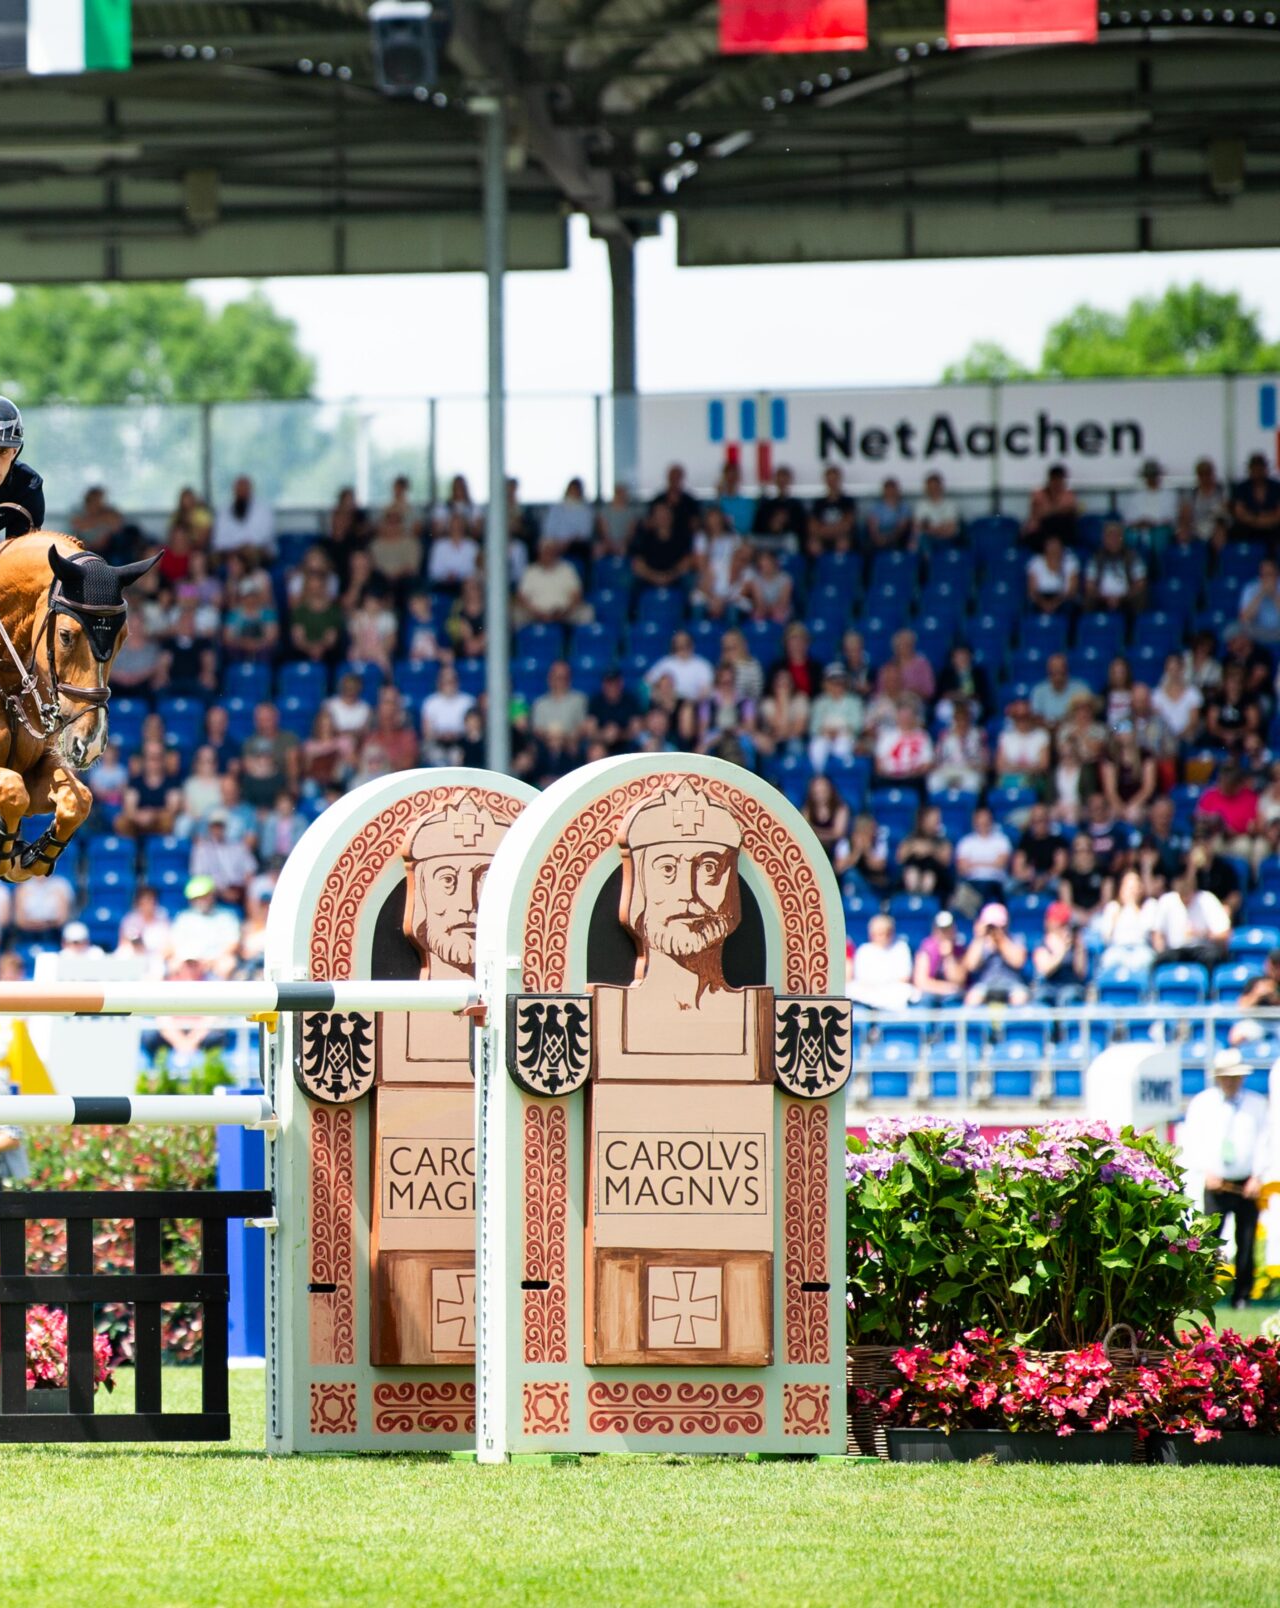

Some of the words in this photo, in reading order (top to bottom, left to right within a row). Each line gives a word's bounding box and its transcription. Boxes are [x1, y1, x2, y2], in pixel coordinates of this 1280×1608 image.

[819, 412, 1144, 460] NetAachen
[605, 1140, 759, 1171] CAROLVS
[389, 1181, 476, 1211] MAG
[605, 1175, 759, 1206] MAGNVS
